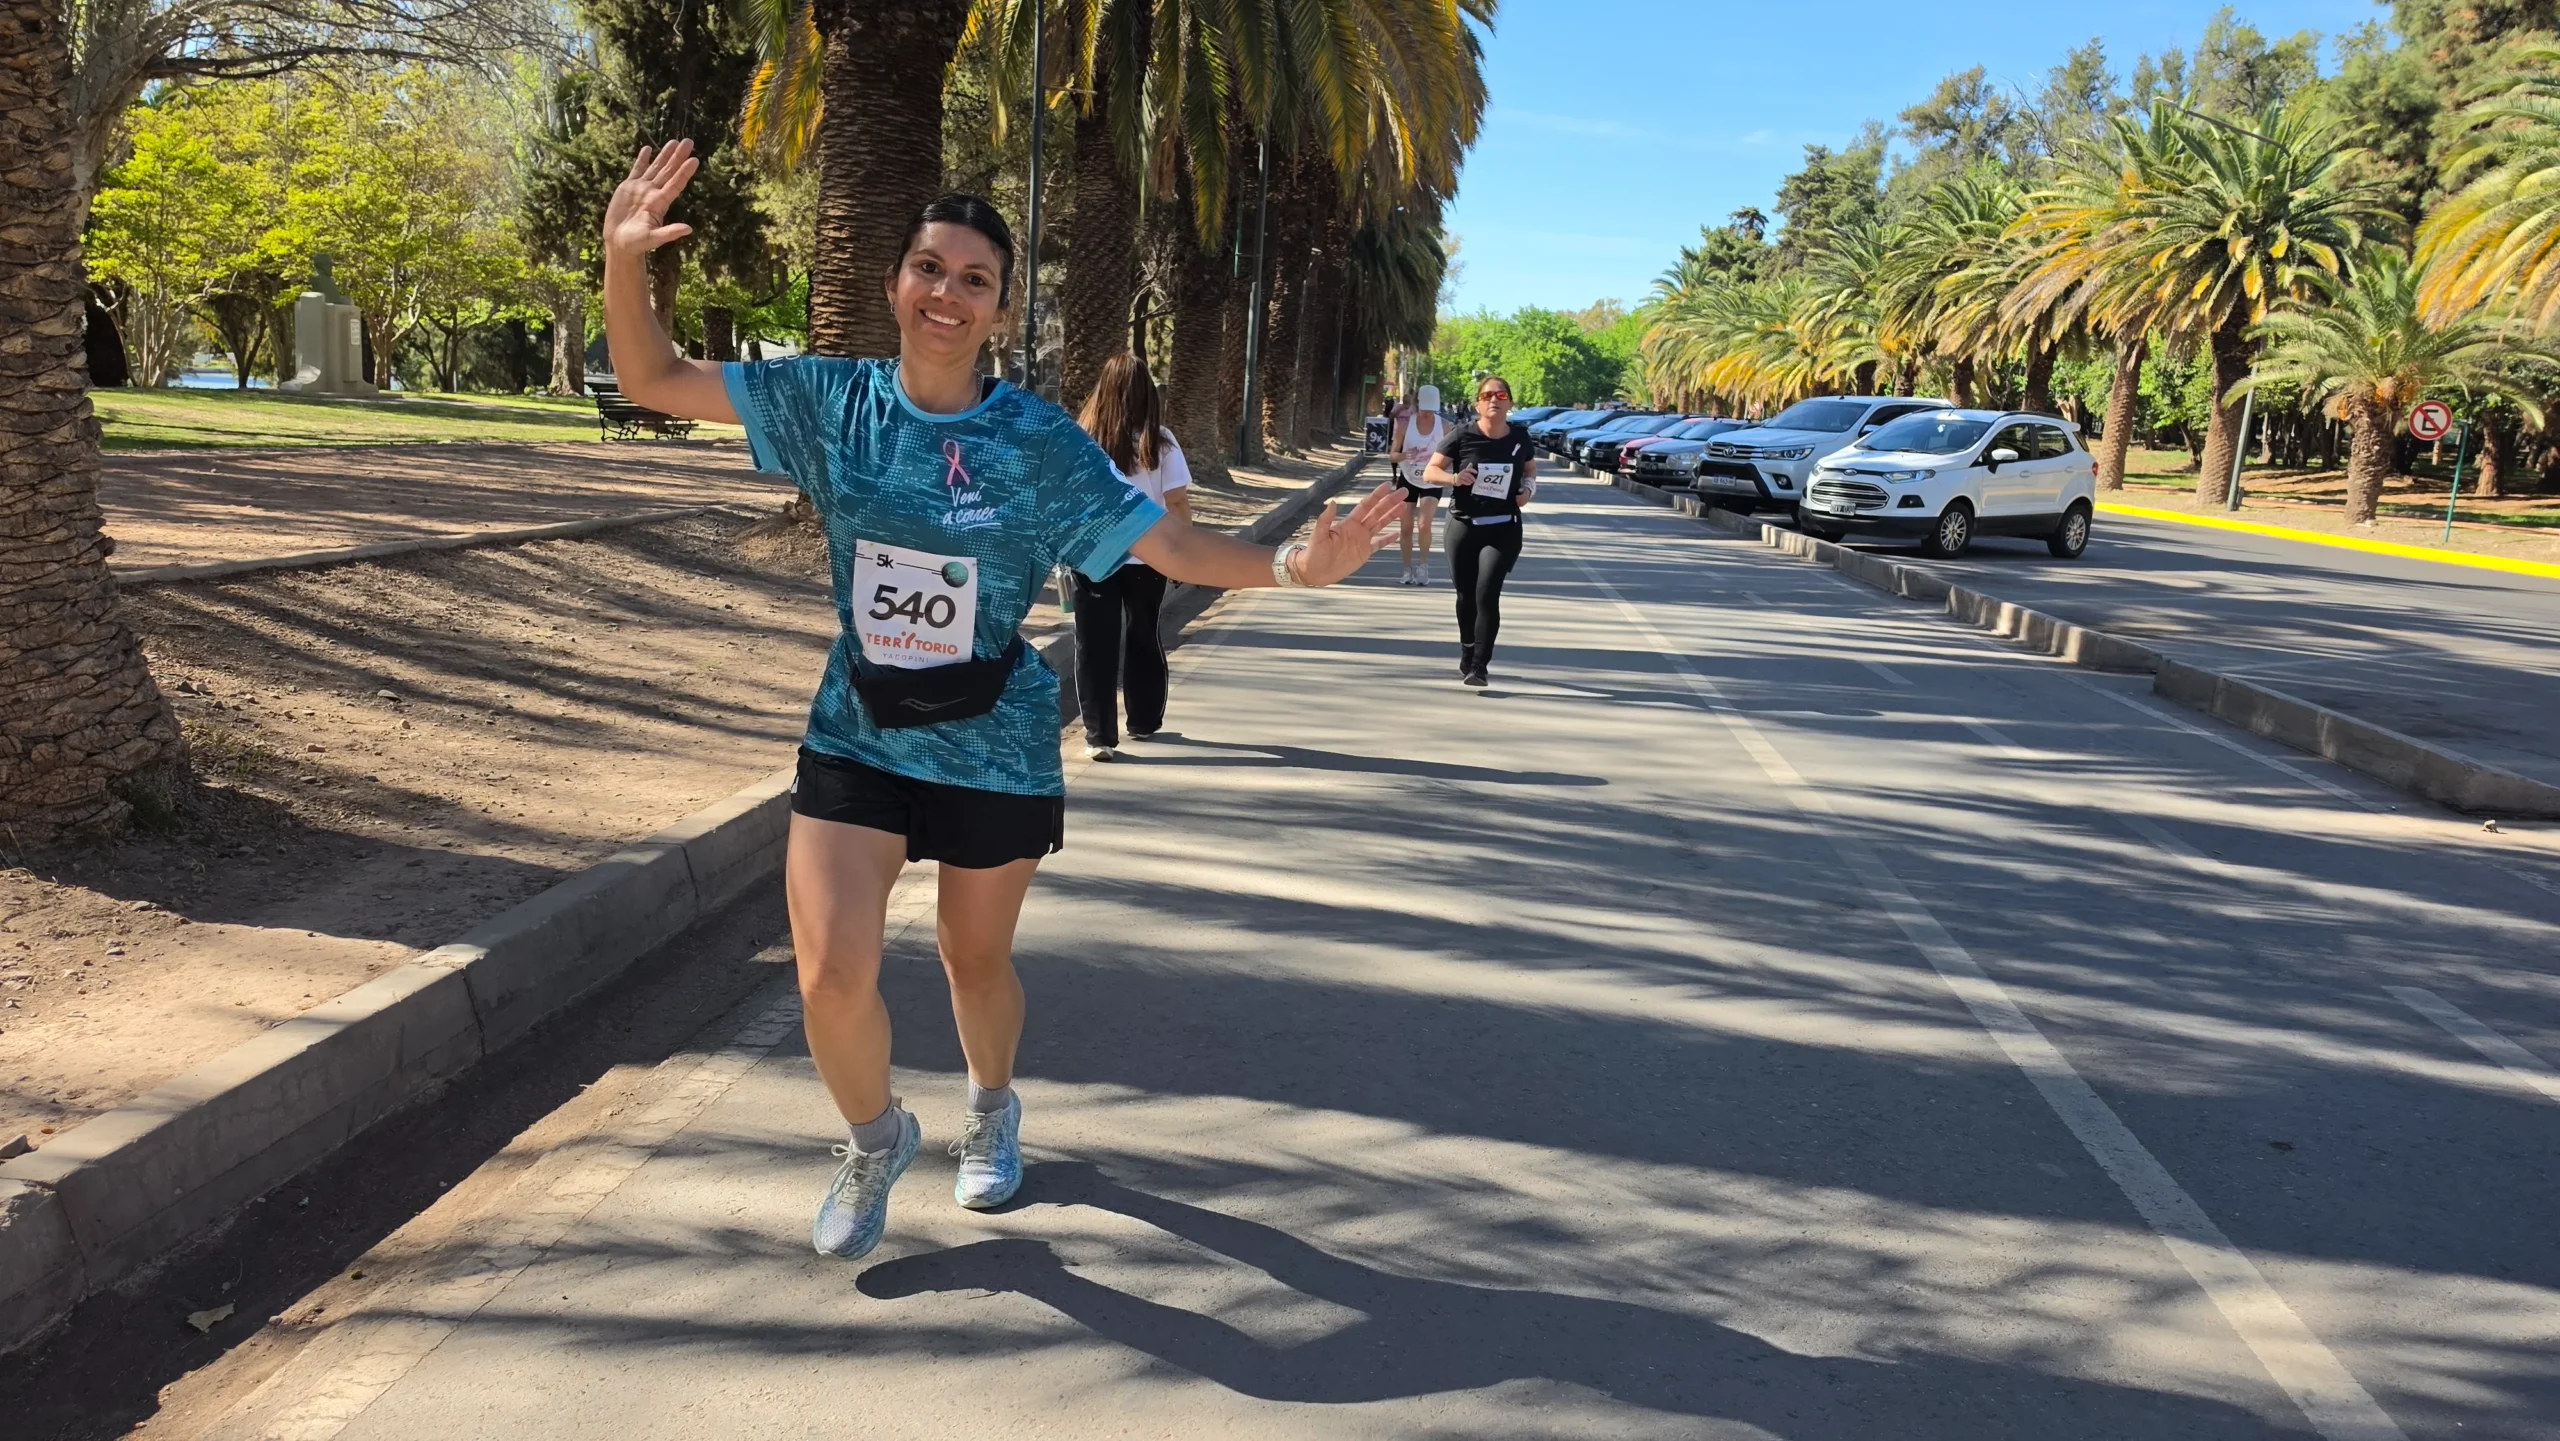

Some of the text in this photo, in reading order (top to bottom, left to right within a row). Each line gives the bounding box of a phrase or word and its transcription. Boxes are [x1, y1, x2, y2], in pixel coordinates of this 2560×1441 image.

[2421, 408, 2440, 432] E
[1483, 474, 1505, 485] 621
[942, 506, 997, 525] a correr
[876, 553, 894, 569] 5k
[868, 583, 957, 629] 540
[882, 652, 930, 664] YACOPINI
